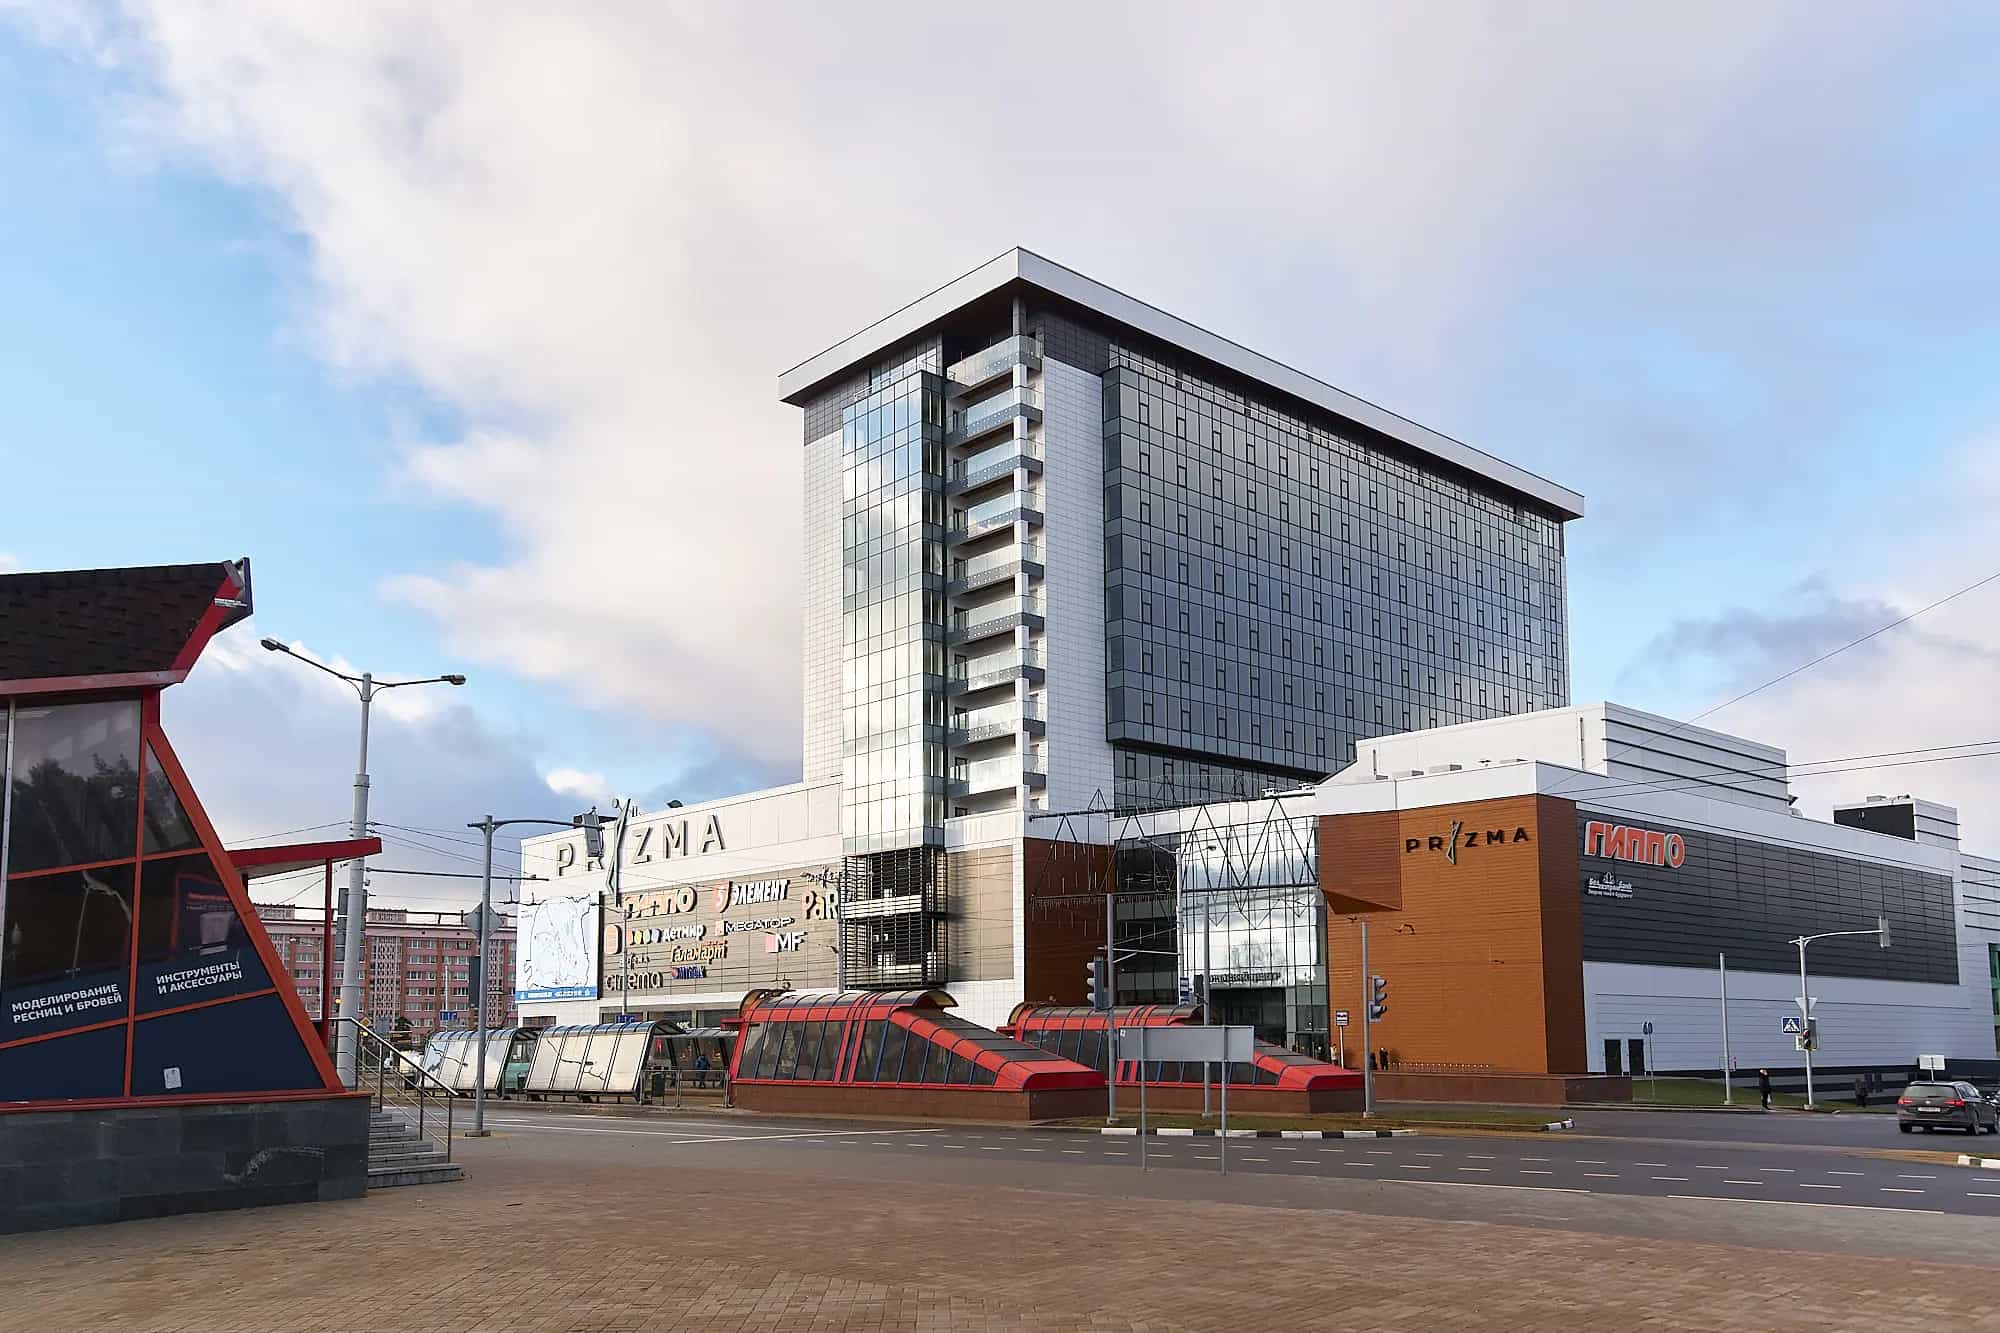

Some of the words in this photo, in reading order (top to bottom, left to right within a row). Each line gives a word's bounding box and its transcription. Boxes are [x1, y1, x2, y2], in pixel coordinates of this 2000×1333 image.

[1584, 820, 1686, 868] ГИППО
[726, 917, 796, 934] MEGATOP
[156, 961, 241, 984] ИНСТРУМЕНТЫ
[157, 985, 167, 995] И
[170, 970, 242, 992] АКСЕССУАРЫ
[11, 983, 119, 1012] МОДЕЛИРОВАНИЕ
[13, 1006, 63, 1024] РЕСНИЦ
[64, 1004, 74, 1013] И
[76, 992, 122, 1011] БРОВЕЙ
